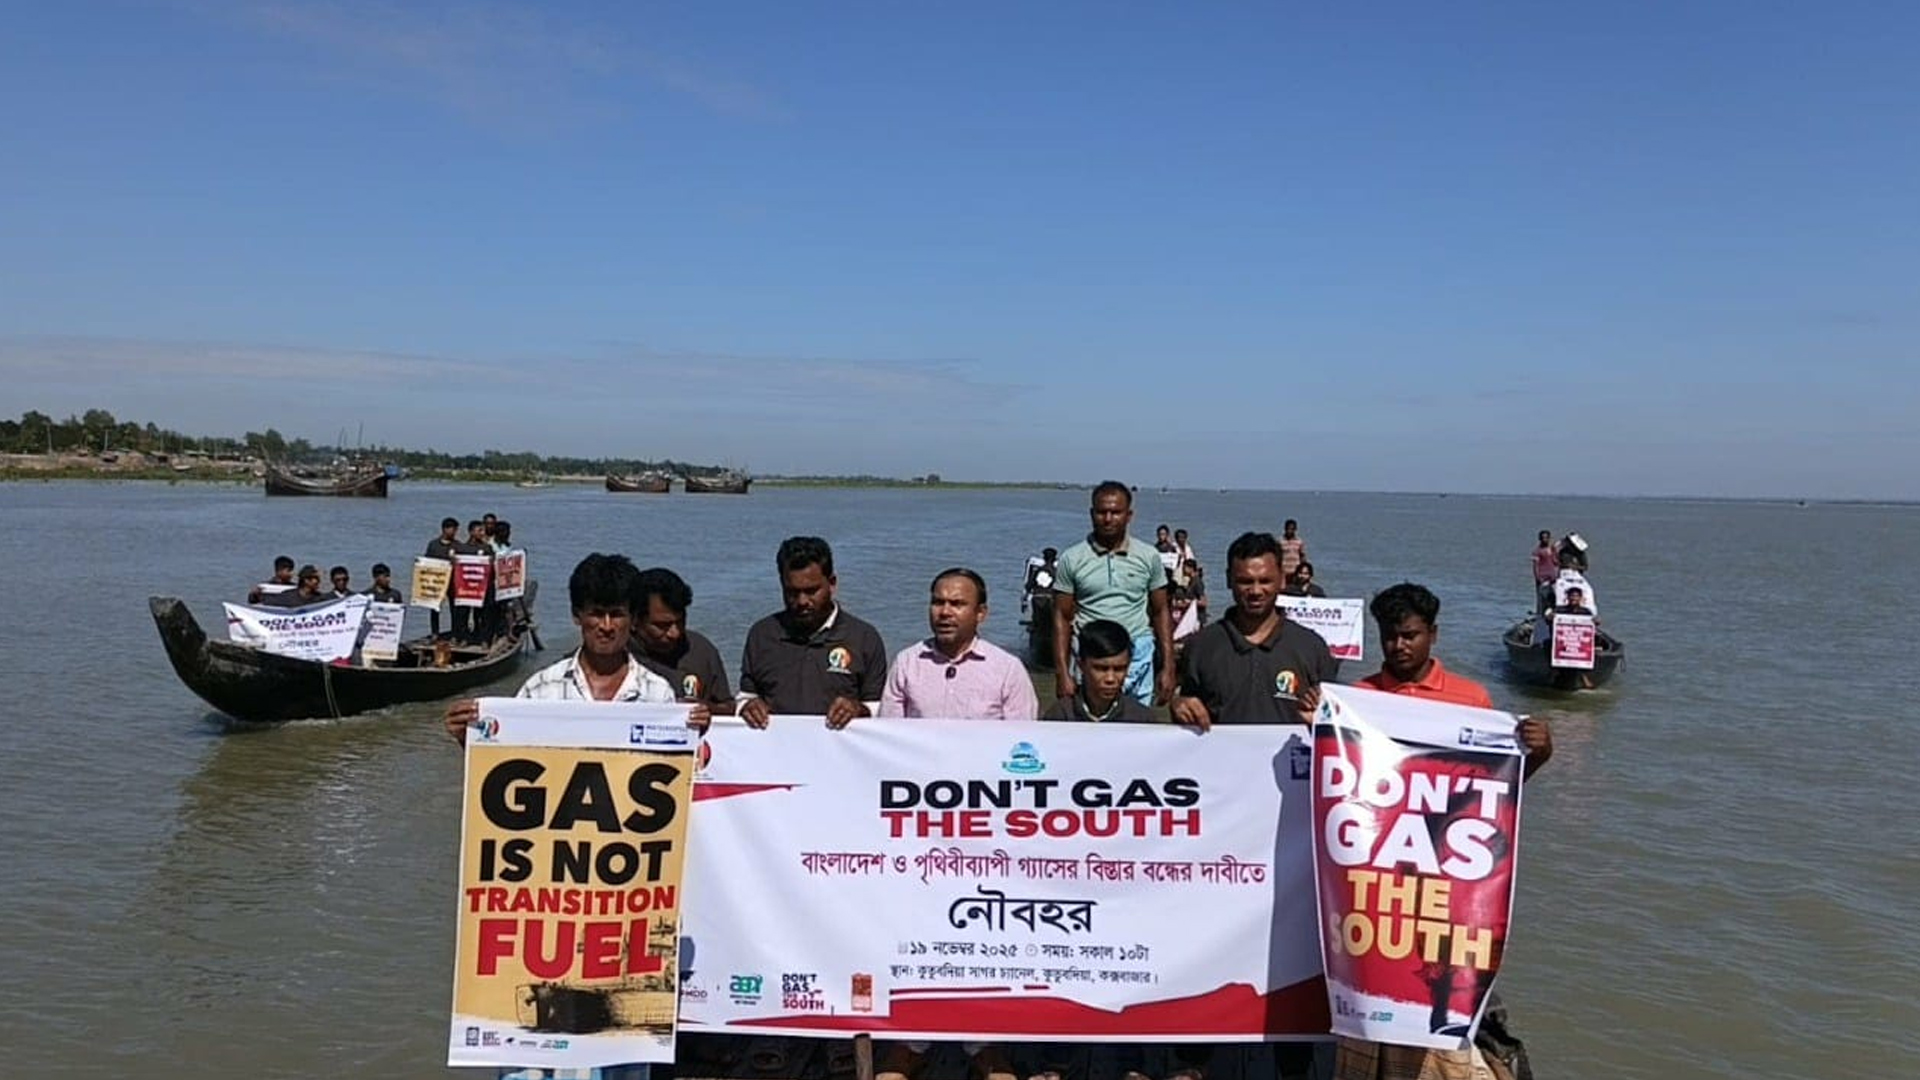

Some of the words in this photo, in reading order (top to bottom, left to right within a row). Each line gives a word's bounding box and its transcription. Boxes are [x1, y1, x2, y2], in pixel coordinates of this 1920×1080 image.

[481, 759, 681, 834] GAS
[881, 778, 1058, 809] DON'T
[1071, 778, 1200, 808] GAS
[1322, 756, 1510, 819] DON'T
[881, 811, 993, 838] THE
[1005, 809, 1200, 838] SOUTH
[1325, 800, 1497, 880] GAS
[480, 839, 534, 882] IS
[552, 840, 672, 885] NOT
[801, 853, 886, 875] বাংলাদেশ
[892, 857, 907, 874] ও
[914, 847, 1011, 884] পৃথিবীব্যাপী
[1018, 857, 1079, 880] গ্যাসের
[1085, 853, 1136, 881] বিস্তার
[1142, 861, 1194, 883] বন্ধের
[1199, 855, 1267, 885] দাবীতে
[466, 885, 675, 915] TRANSITION
[948, 884, 1098, 933] নৌবহর
[1347, 869, 1451, 921] THE
[477, 918, 661, 979] FUEL
[910, 941, 927, 955] ১৯
[931, 942, 975, 956] নভেম্বর
[980, 943, 1018, 957] ২০২৫
[1079, 946, 1114, 960] সকাল
[1119, 944, 1150, 961] ১০টা
[1329, 912, 1493, 971] SOUTH
[782, 982, 811, 993] GAS
[917, 962, 965, 980] কুতুবদিয়া
[969, 966, 997, 979] সাগর
[782, 999, 825, 1011] SOUTH
